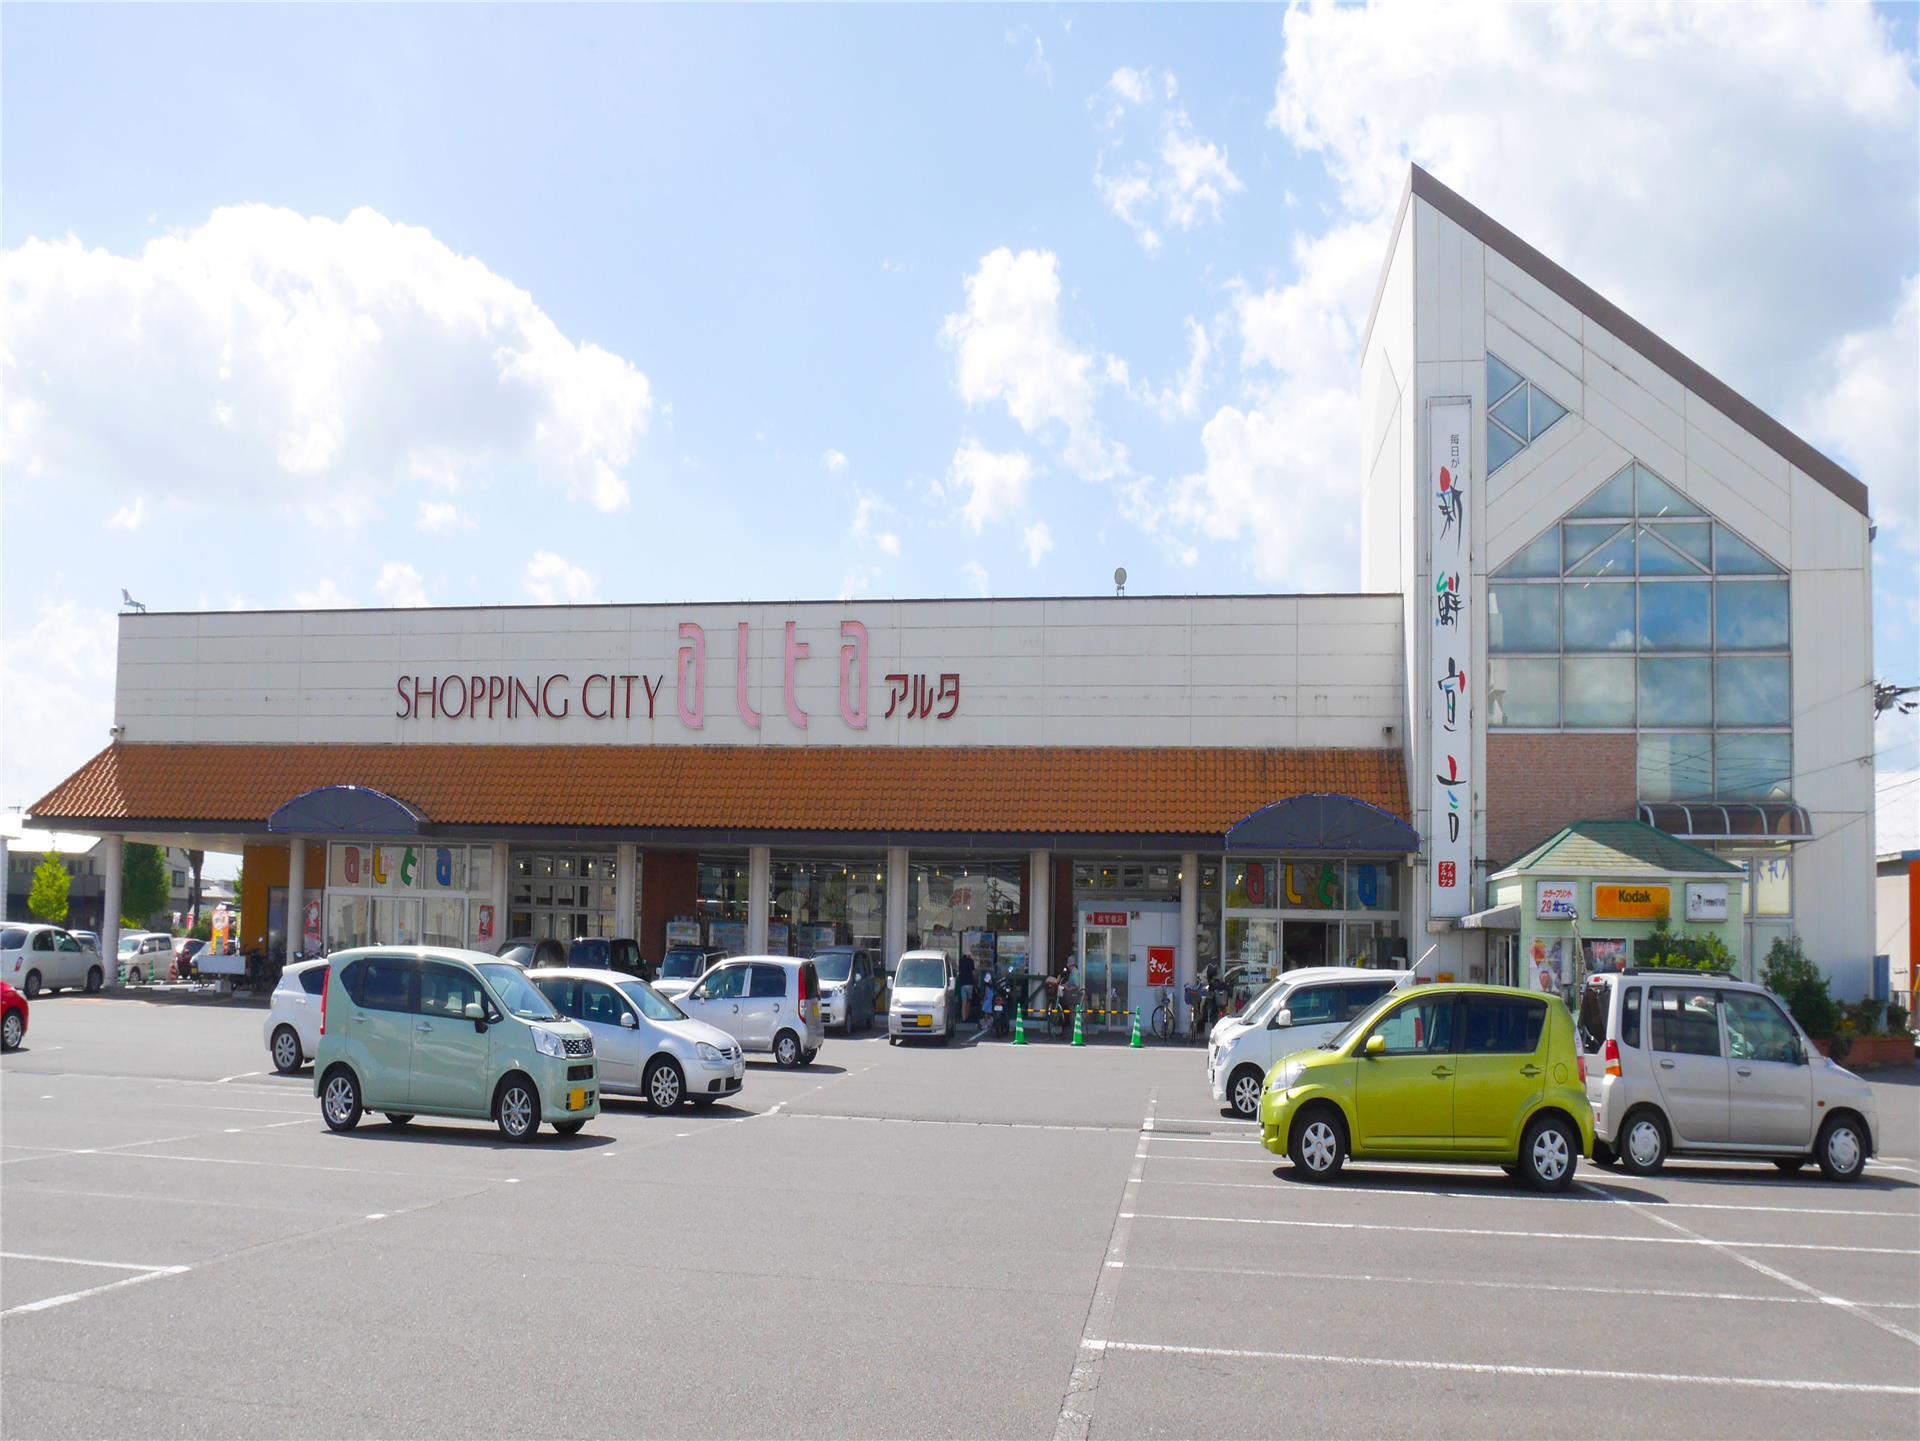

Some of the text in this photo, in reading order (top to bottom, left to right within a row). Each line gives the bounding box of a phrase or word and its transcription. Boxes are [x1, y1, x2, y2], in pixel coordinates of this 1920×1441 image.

[1450, 434, 1460, 468] 毎日が
[396, 620, 961, 731] SHOPPING CITY alta アルタ
[1618, 890, 1652, 903] Kodak
